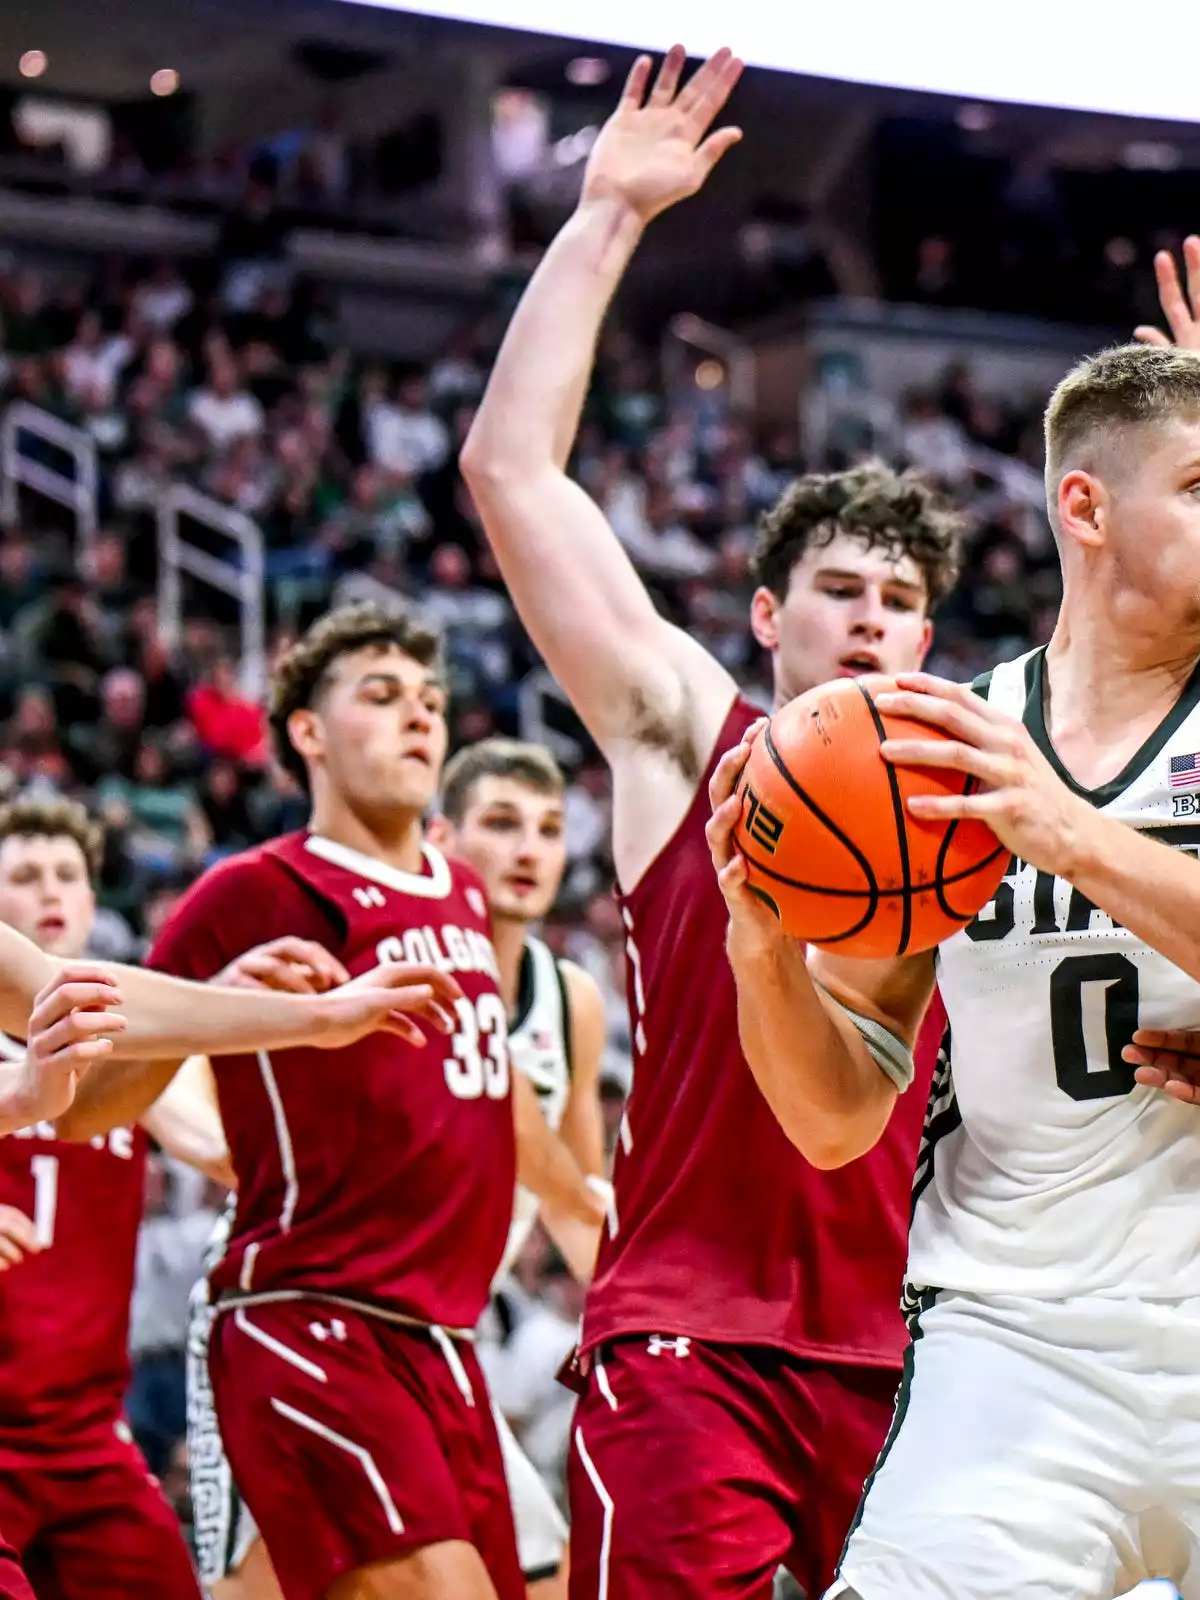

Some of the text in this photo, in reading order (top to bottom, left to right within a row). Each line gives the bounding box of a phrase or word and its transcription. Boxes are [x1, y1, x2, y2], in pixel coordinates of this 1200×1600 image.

[443, 992, 509, 1100] 33
[1050, 952, 1139, 1102] 0
[31, 1154, 59, 1249] 1
